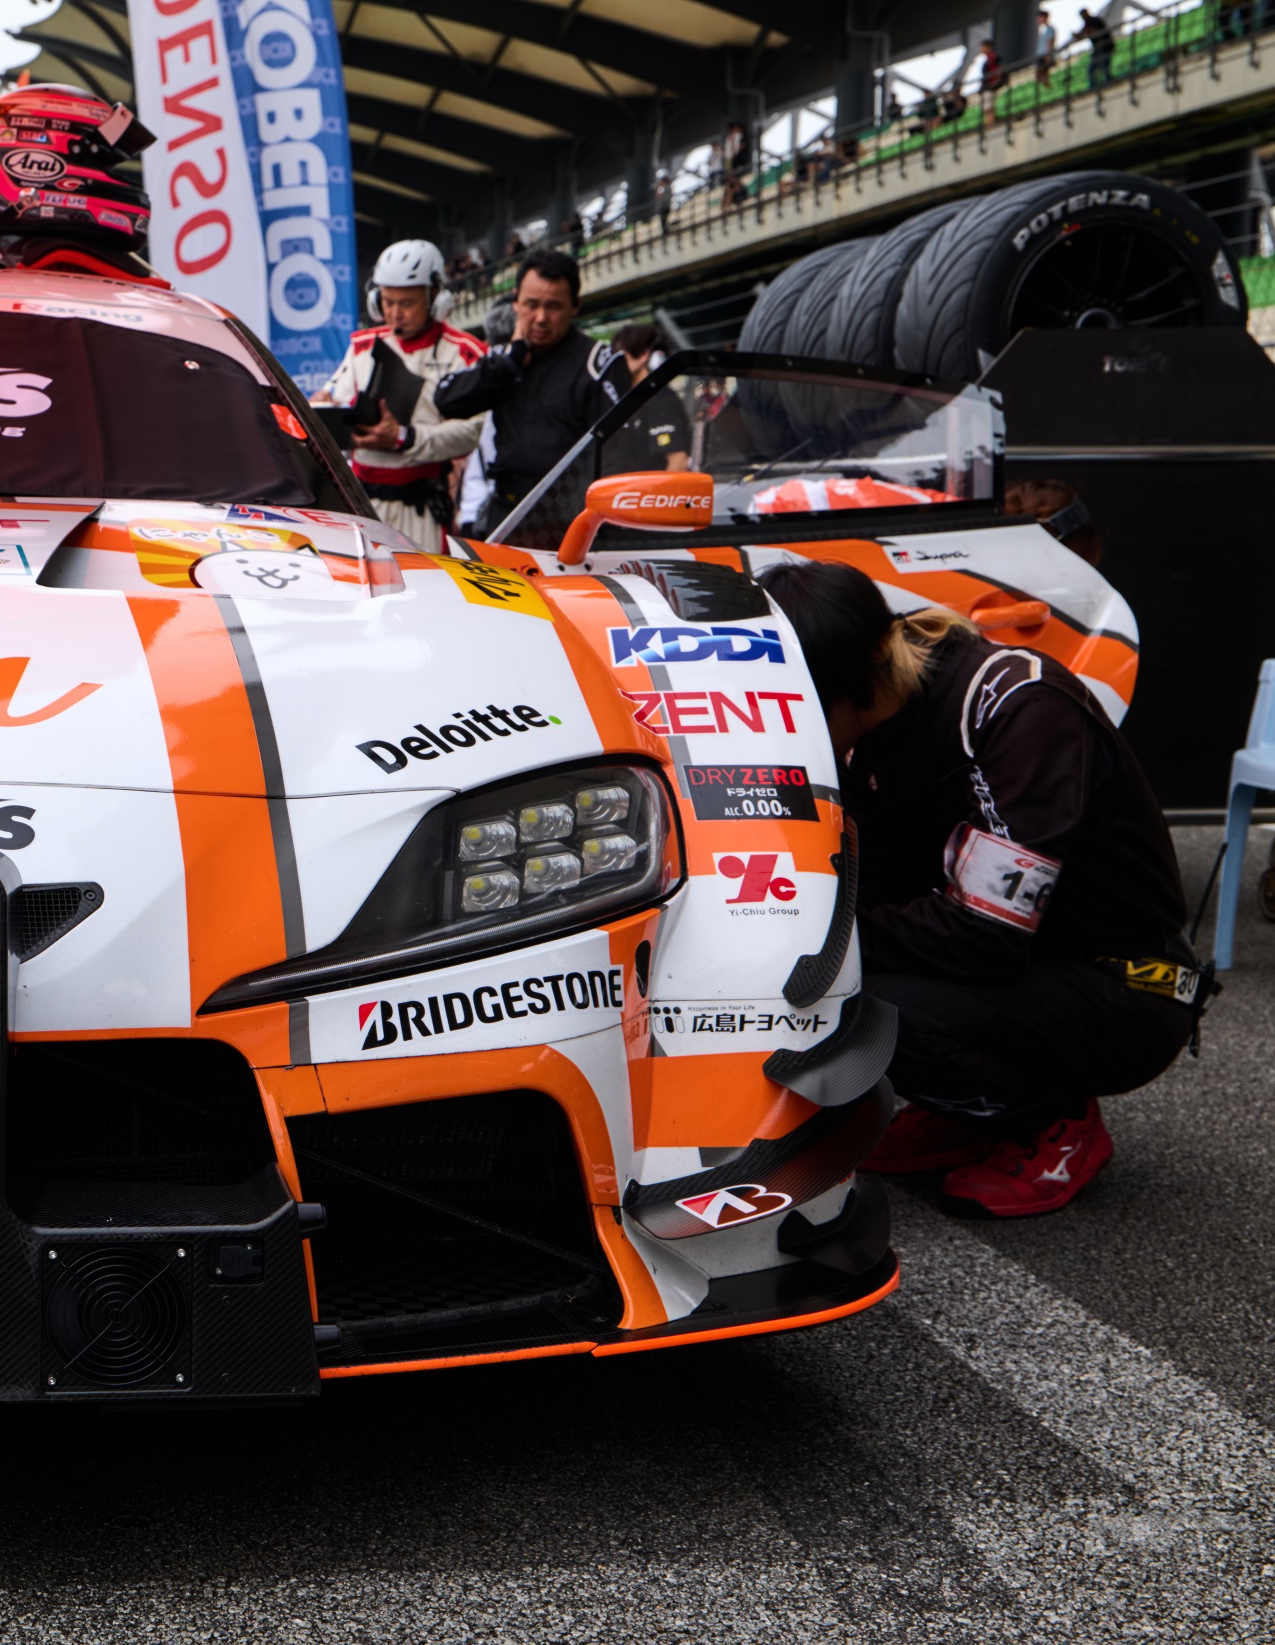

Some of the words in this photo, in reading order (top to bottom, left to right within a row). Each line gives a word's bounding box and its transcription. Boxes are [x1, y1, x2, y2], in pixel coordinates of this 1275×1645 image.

[8, 153, 57, 171] Arai
[1012, 189, 1151, 251] POTENZA
[12, 302, 144, 323] Racing
[640, 495, 712, 508] EDIFICE
[611, 627, 785, 664] KDDI
[619, 691, 804, 735] ZENT
[355, 704, 562, 775] Deloitte.
[727, 788, 778, 797] ドライゼロ
[725, 806, 743, 816] ALC.
[729, 907, 765, 917] Yi-Chiu
[768, 907, 800, 917] Group
[358, 969, 623, 1050] BRIDGESTONE
[692, 1013, 829, 1033] 広島トヨペット
